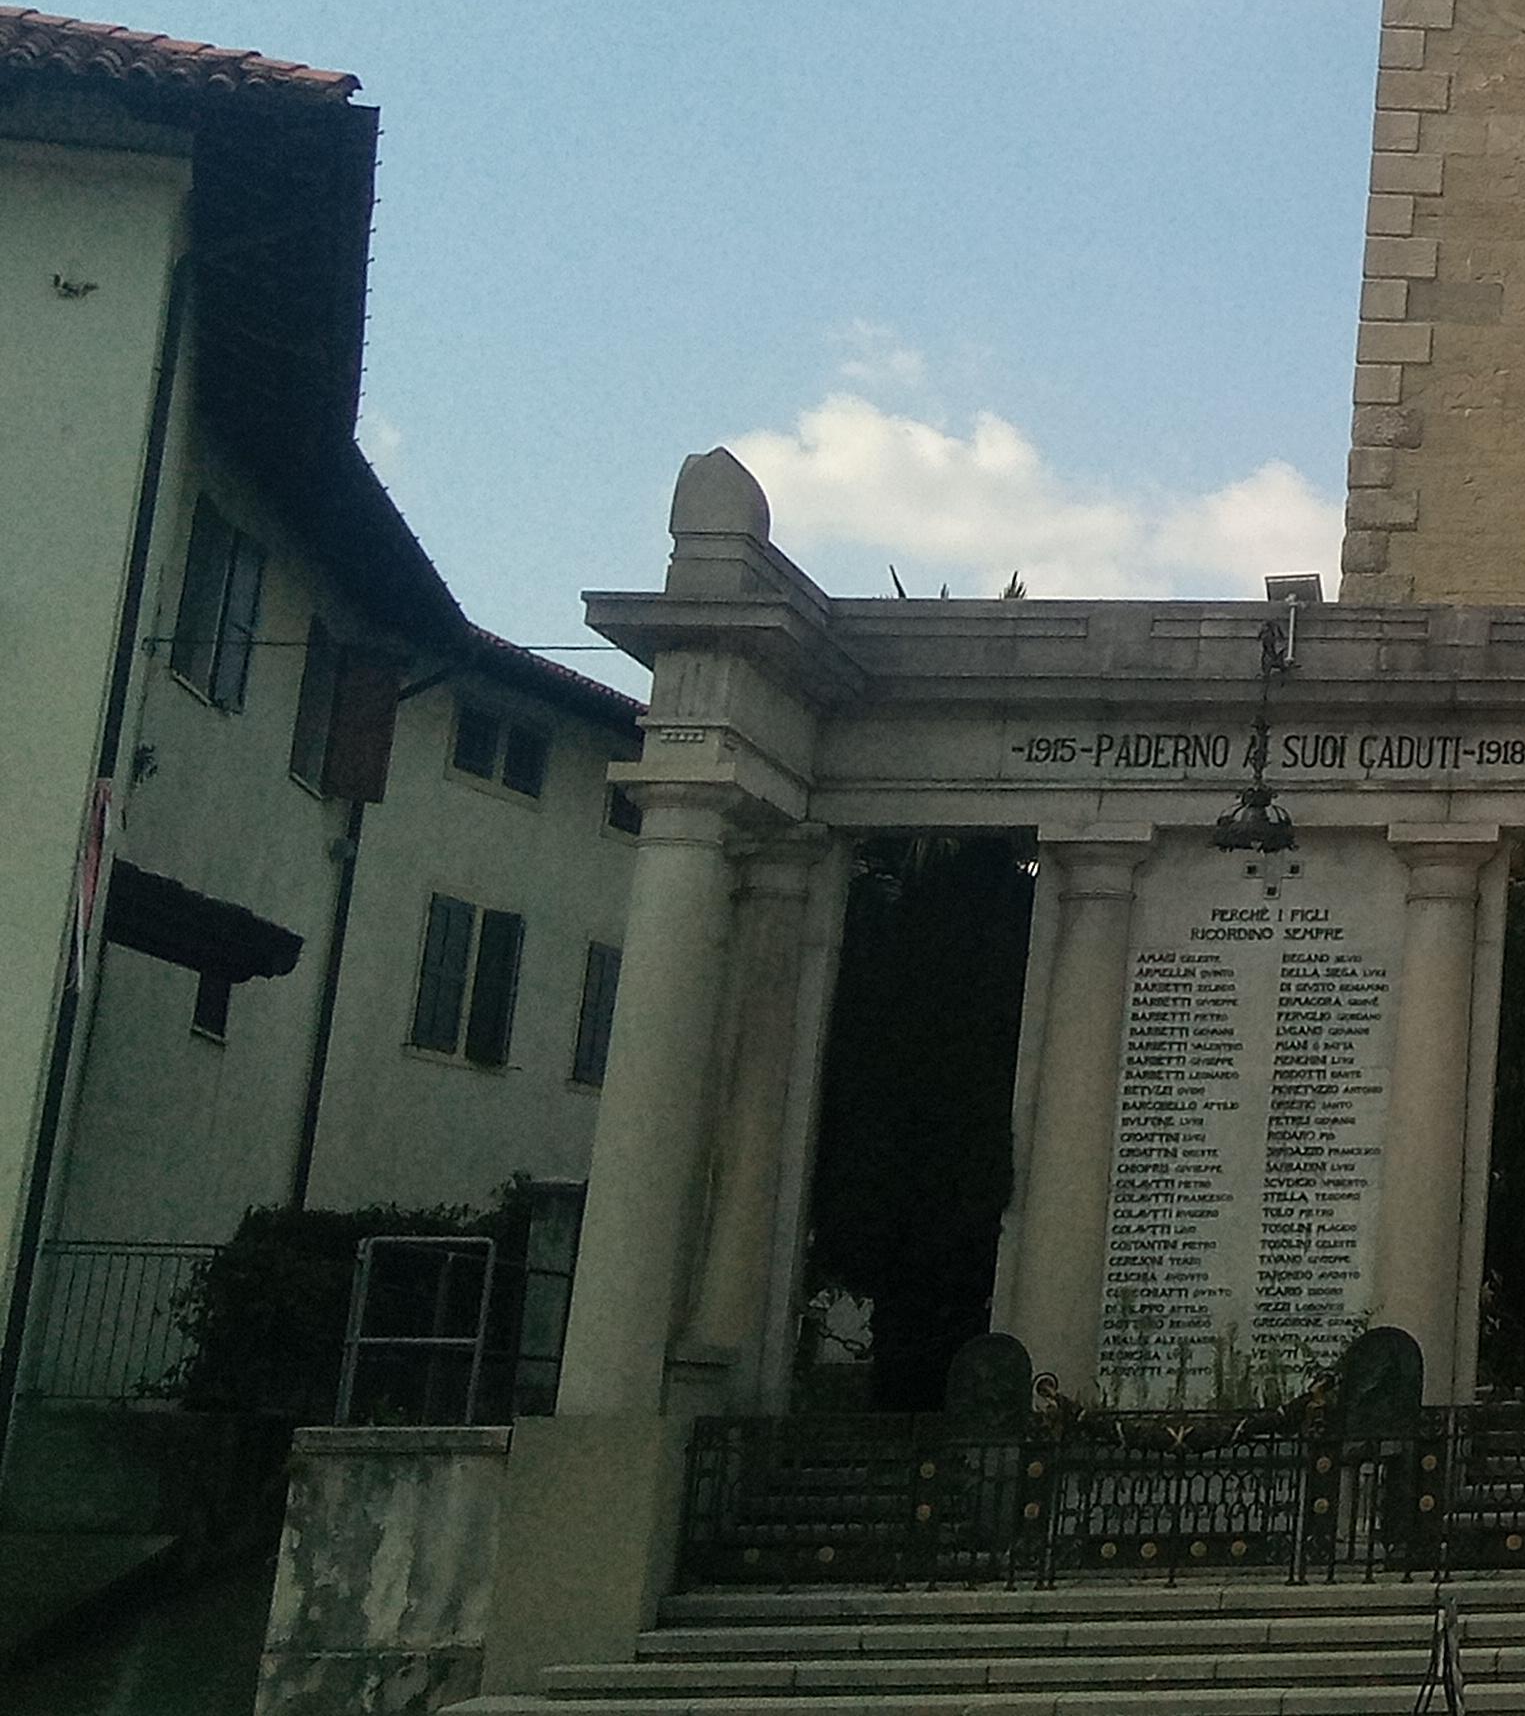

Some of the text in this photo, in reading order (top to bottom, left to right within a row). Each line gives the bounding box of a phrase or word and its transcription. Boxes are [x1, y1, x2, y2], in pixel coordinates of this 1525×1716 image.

[1282, 735, 1348, 768] SUOI
[1277, 908, 1283, 922] I
[1290, 908, 1330, 922] FIGLI
[1190, 927, 1345, 941] RICORDINO SEMPRE
